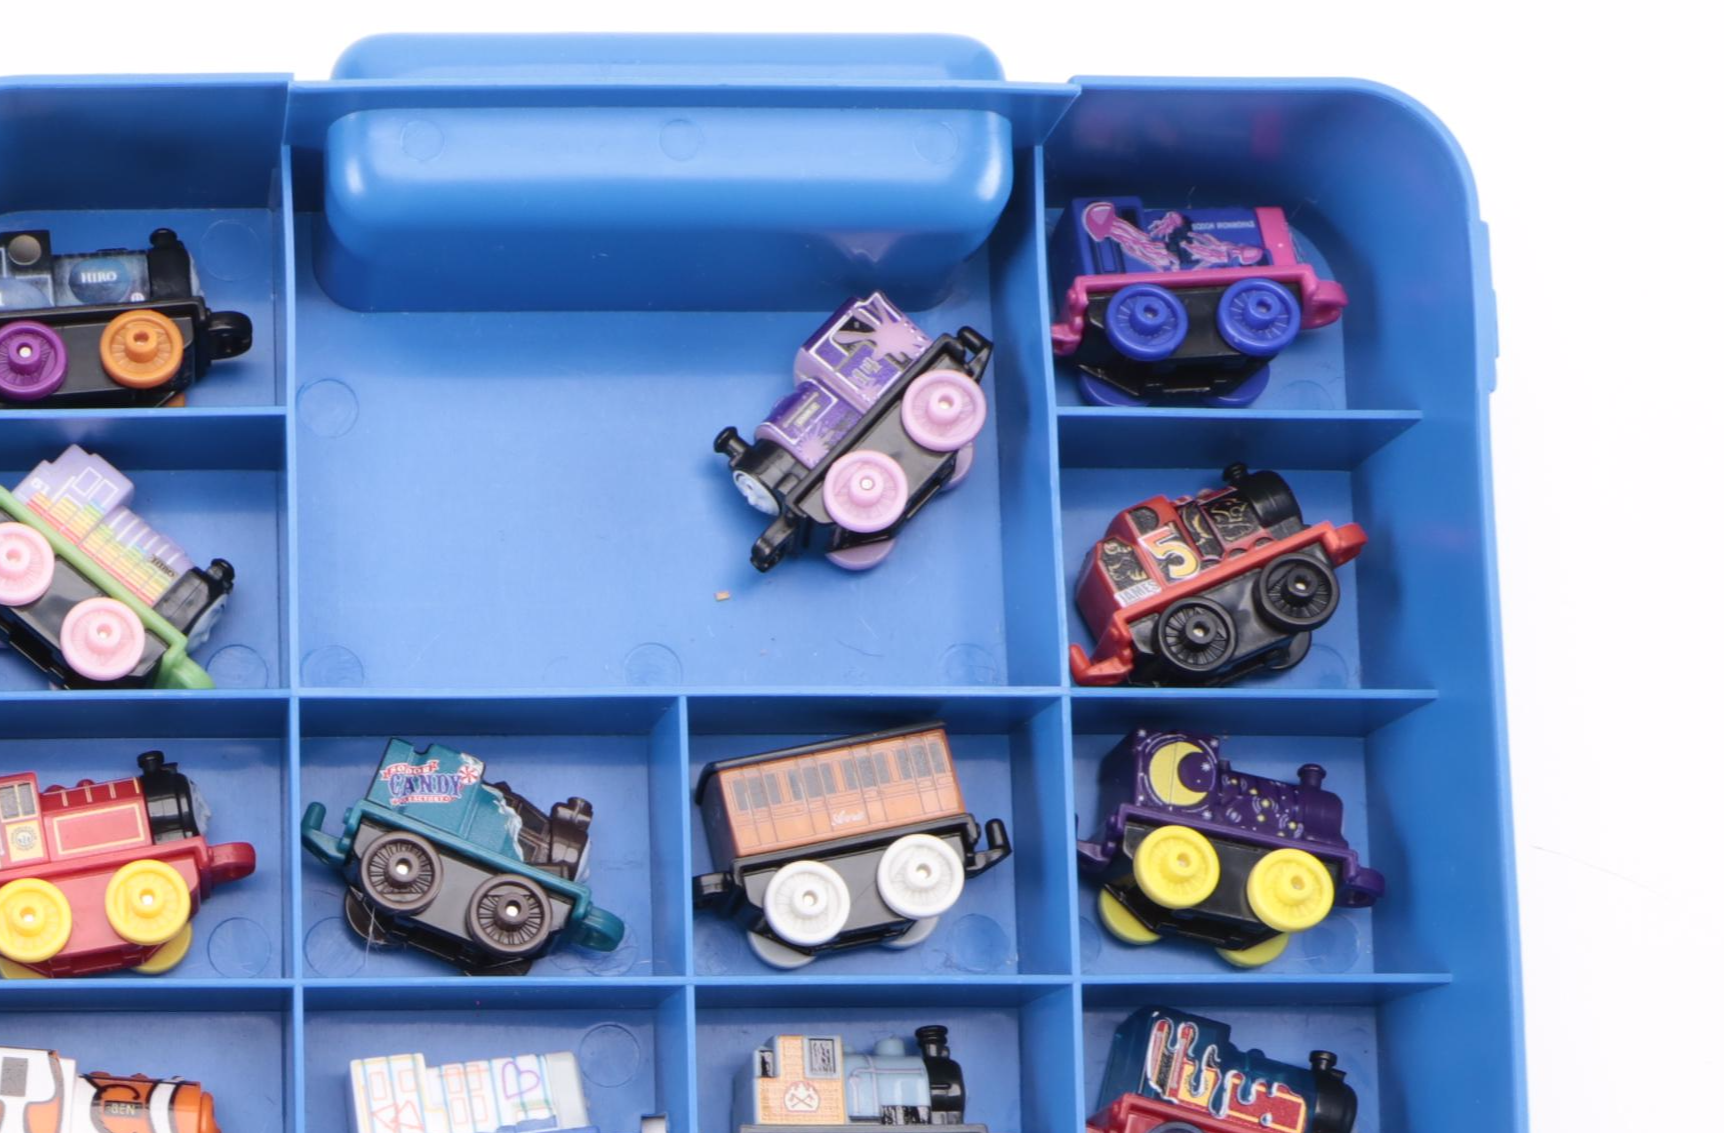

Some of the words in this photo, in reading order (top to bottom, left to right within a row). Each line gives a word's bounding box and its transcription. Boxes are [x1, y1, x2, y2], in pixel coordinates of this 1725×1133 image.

[80, 270, 118, 283] HIRO
[1137, 521, 1201, 579] 5
[1116, 580, 1161, 606] JAMES
[388, 773, 462, 798] CANDY
[111, 1103, 136, 1115] BEN
